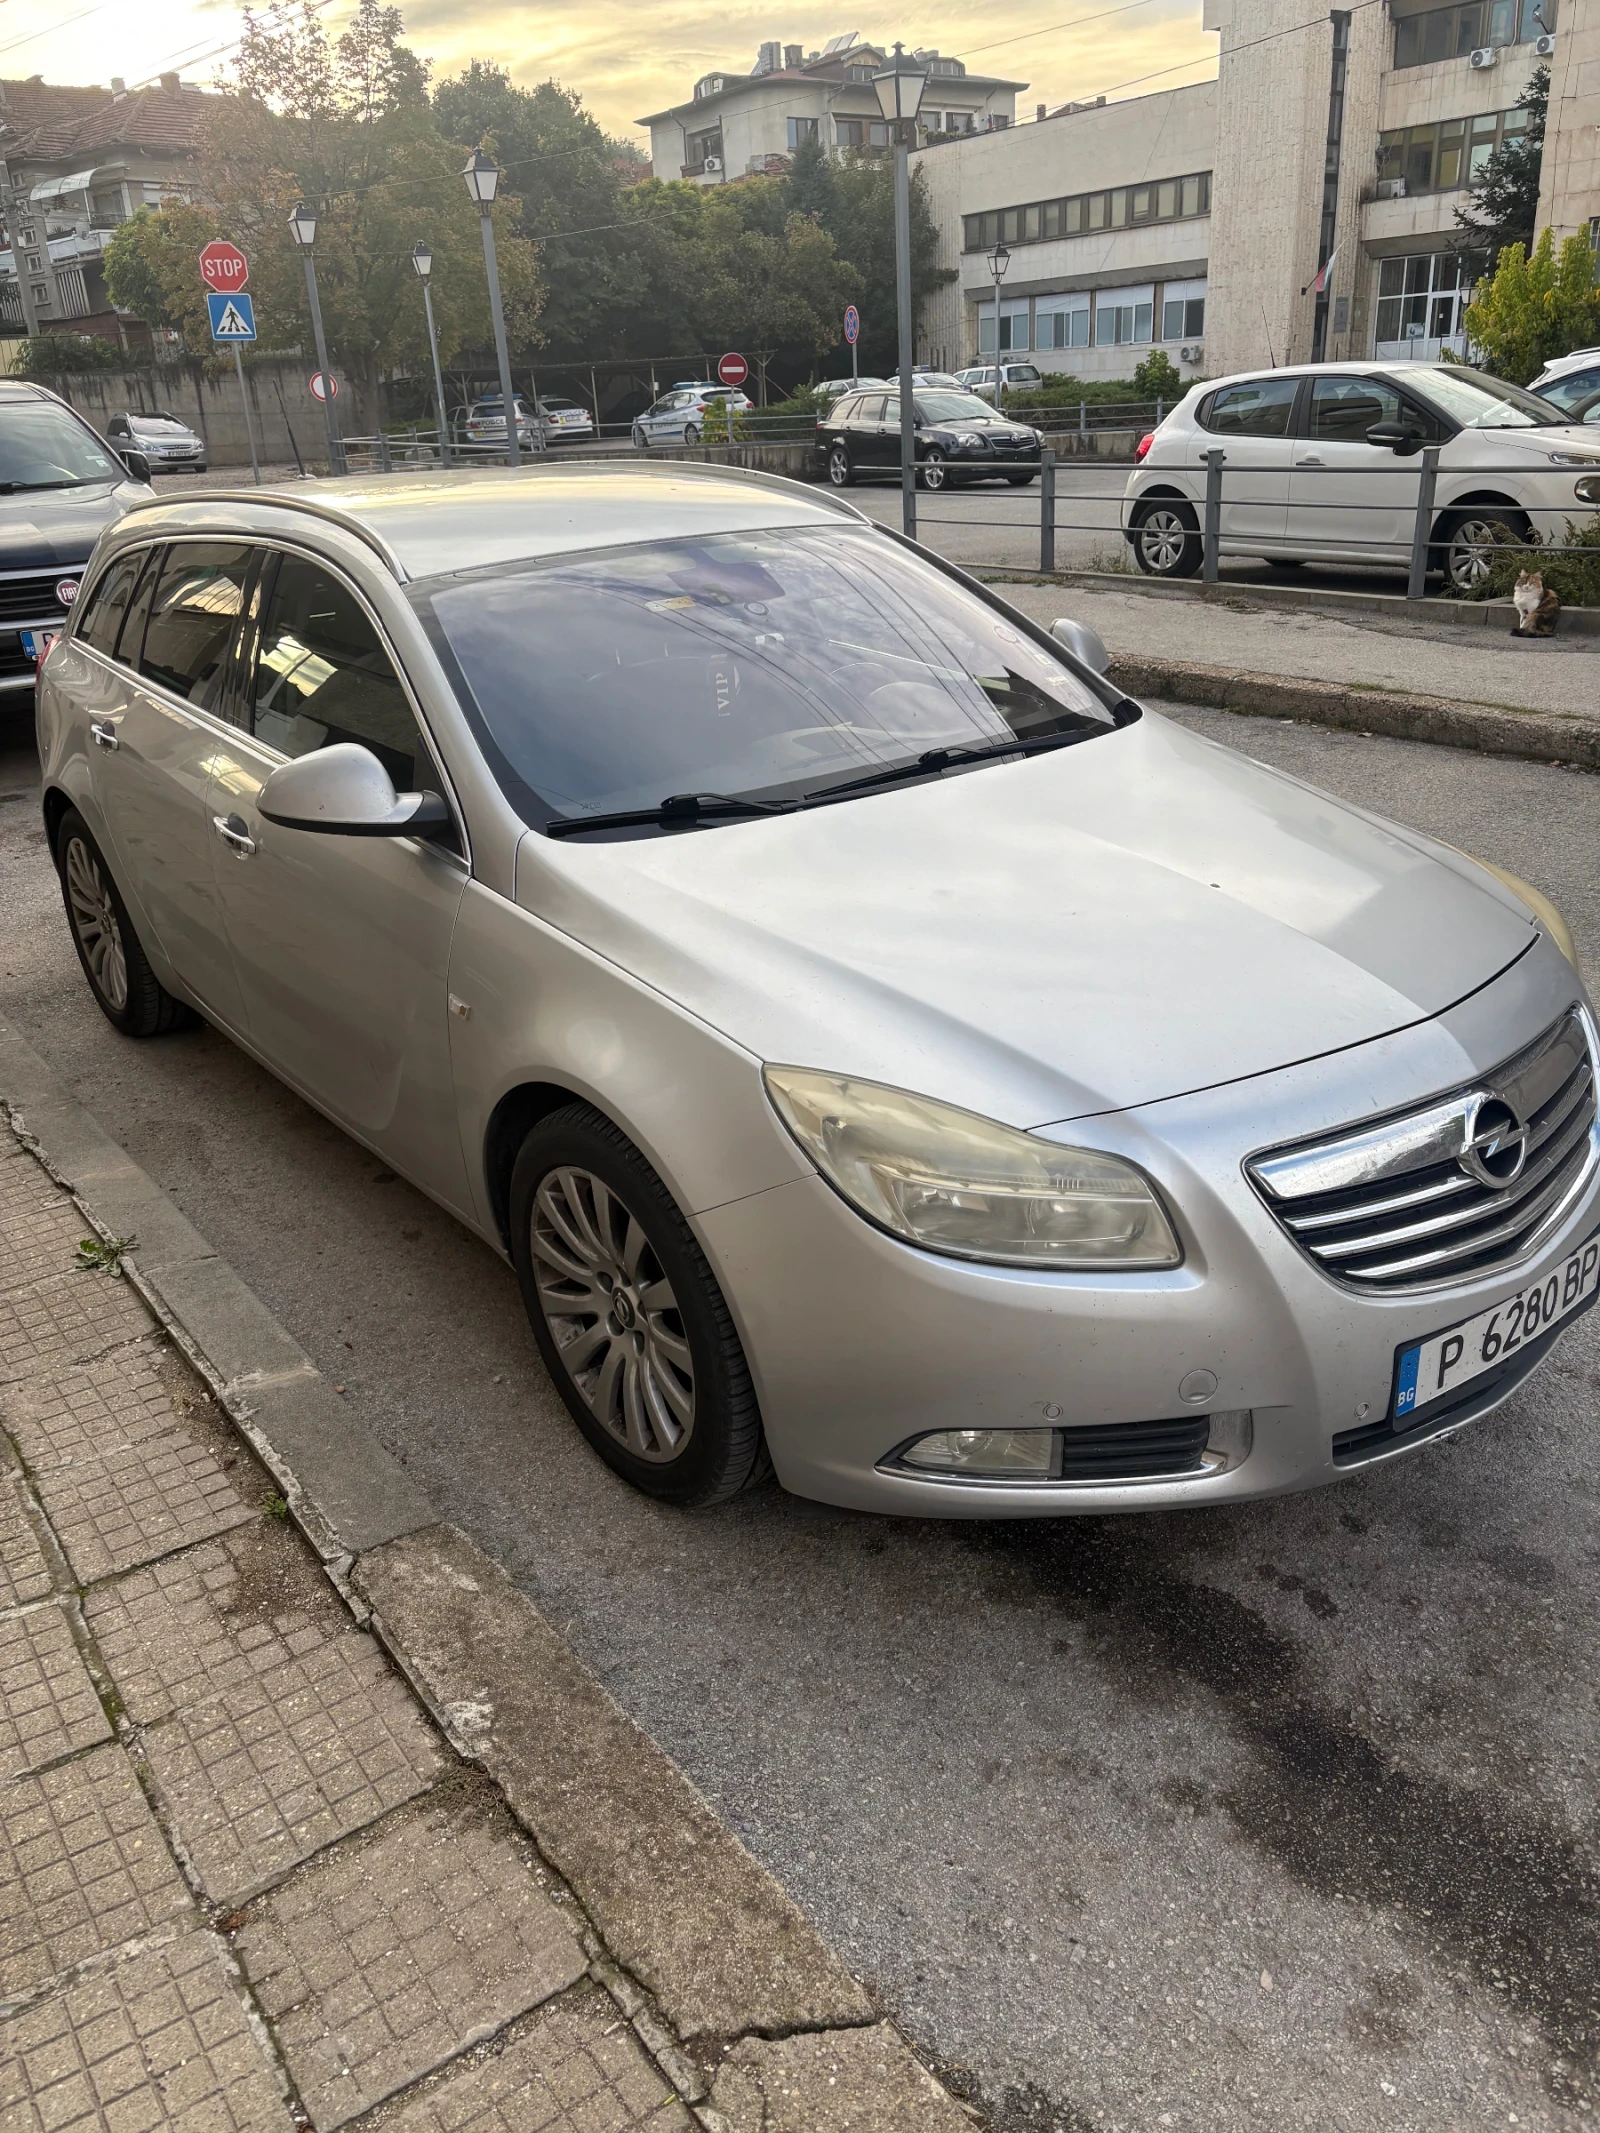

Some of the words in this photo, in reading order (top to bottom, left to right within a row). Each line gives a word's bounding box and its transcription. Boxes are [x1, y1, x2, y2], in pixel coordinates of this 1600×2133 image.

[205, 259, 242, 277] STOP
[481, 418, 504, 426] POLICE
[62, 587, 77, 600] FIAT
[715, 672, 730, 710] VIP
[1398, 1387, 1414, 1406] BG
[1437, 1335, 1464, 1389] P
[1481, 1275, 1558, 1362] 6280
[1562, 1243, 1598, 1309] BP
